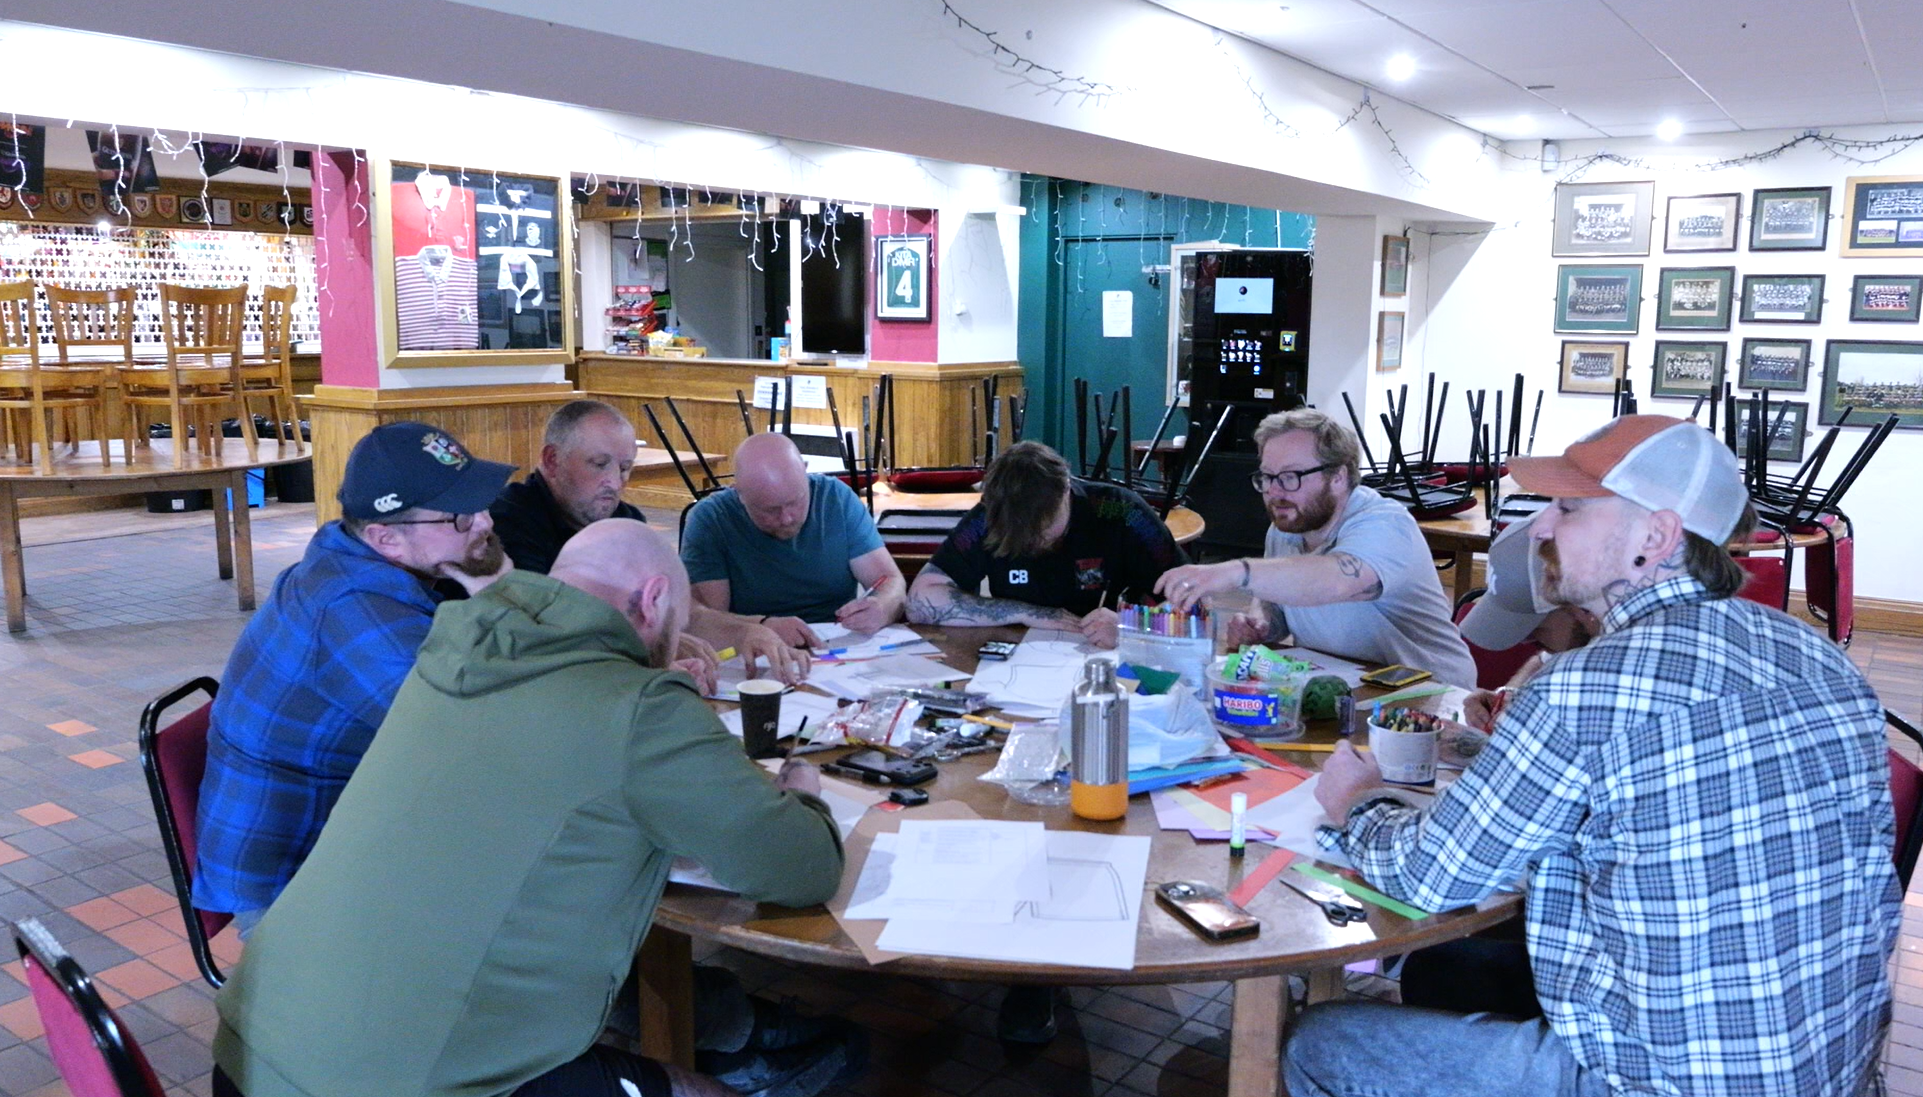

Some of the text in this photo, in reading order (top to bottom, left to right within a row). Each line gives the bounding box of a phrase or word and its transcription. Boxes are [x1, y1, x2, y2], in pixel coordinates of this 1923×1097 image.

[895, 270, 913, 303] 4
[1009, 569, 1028, 584] CB
[1223, 696, 1263, 711] HARIBO
